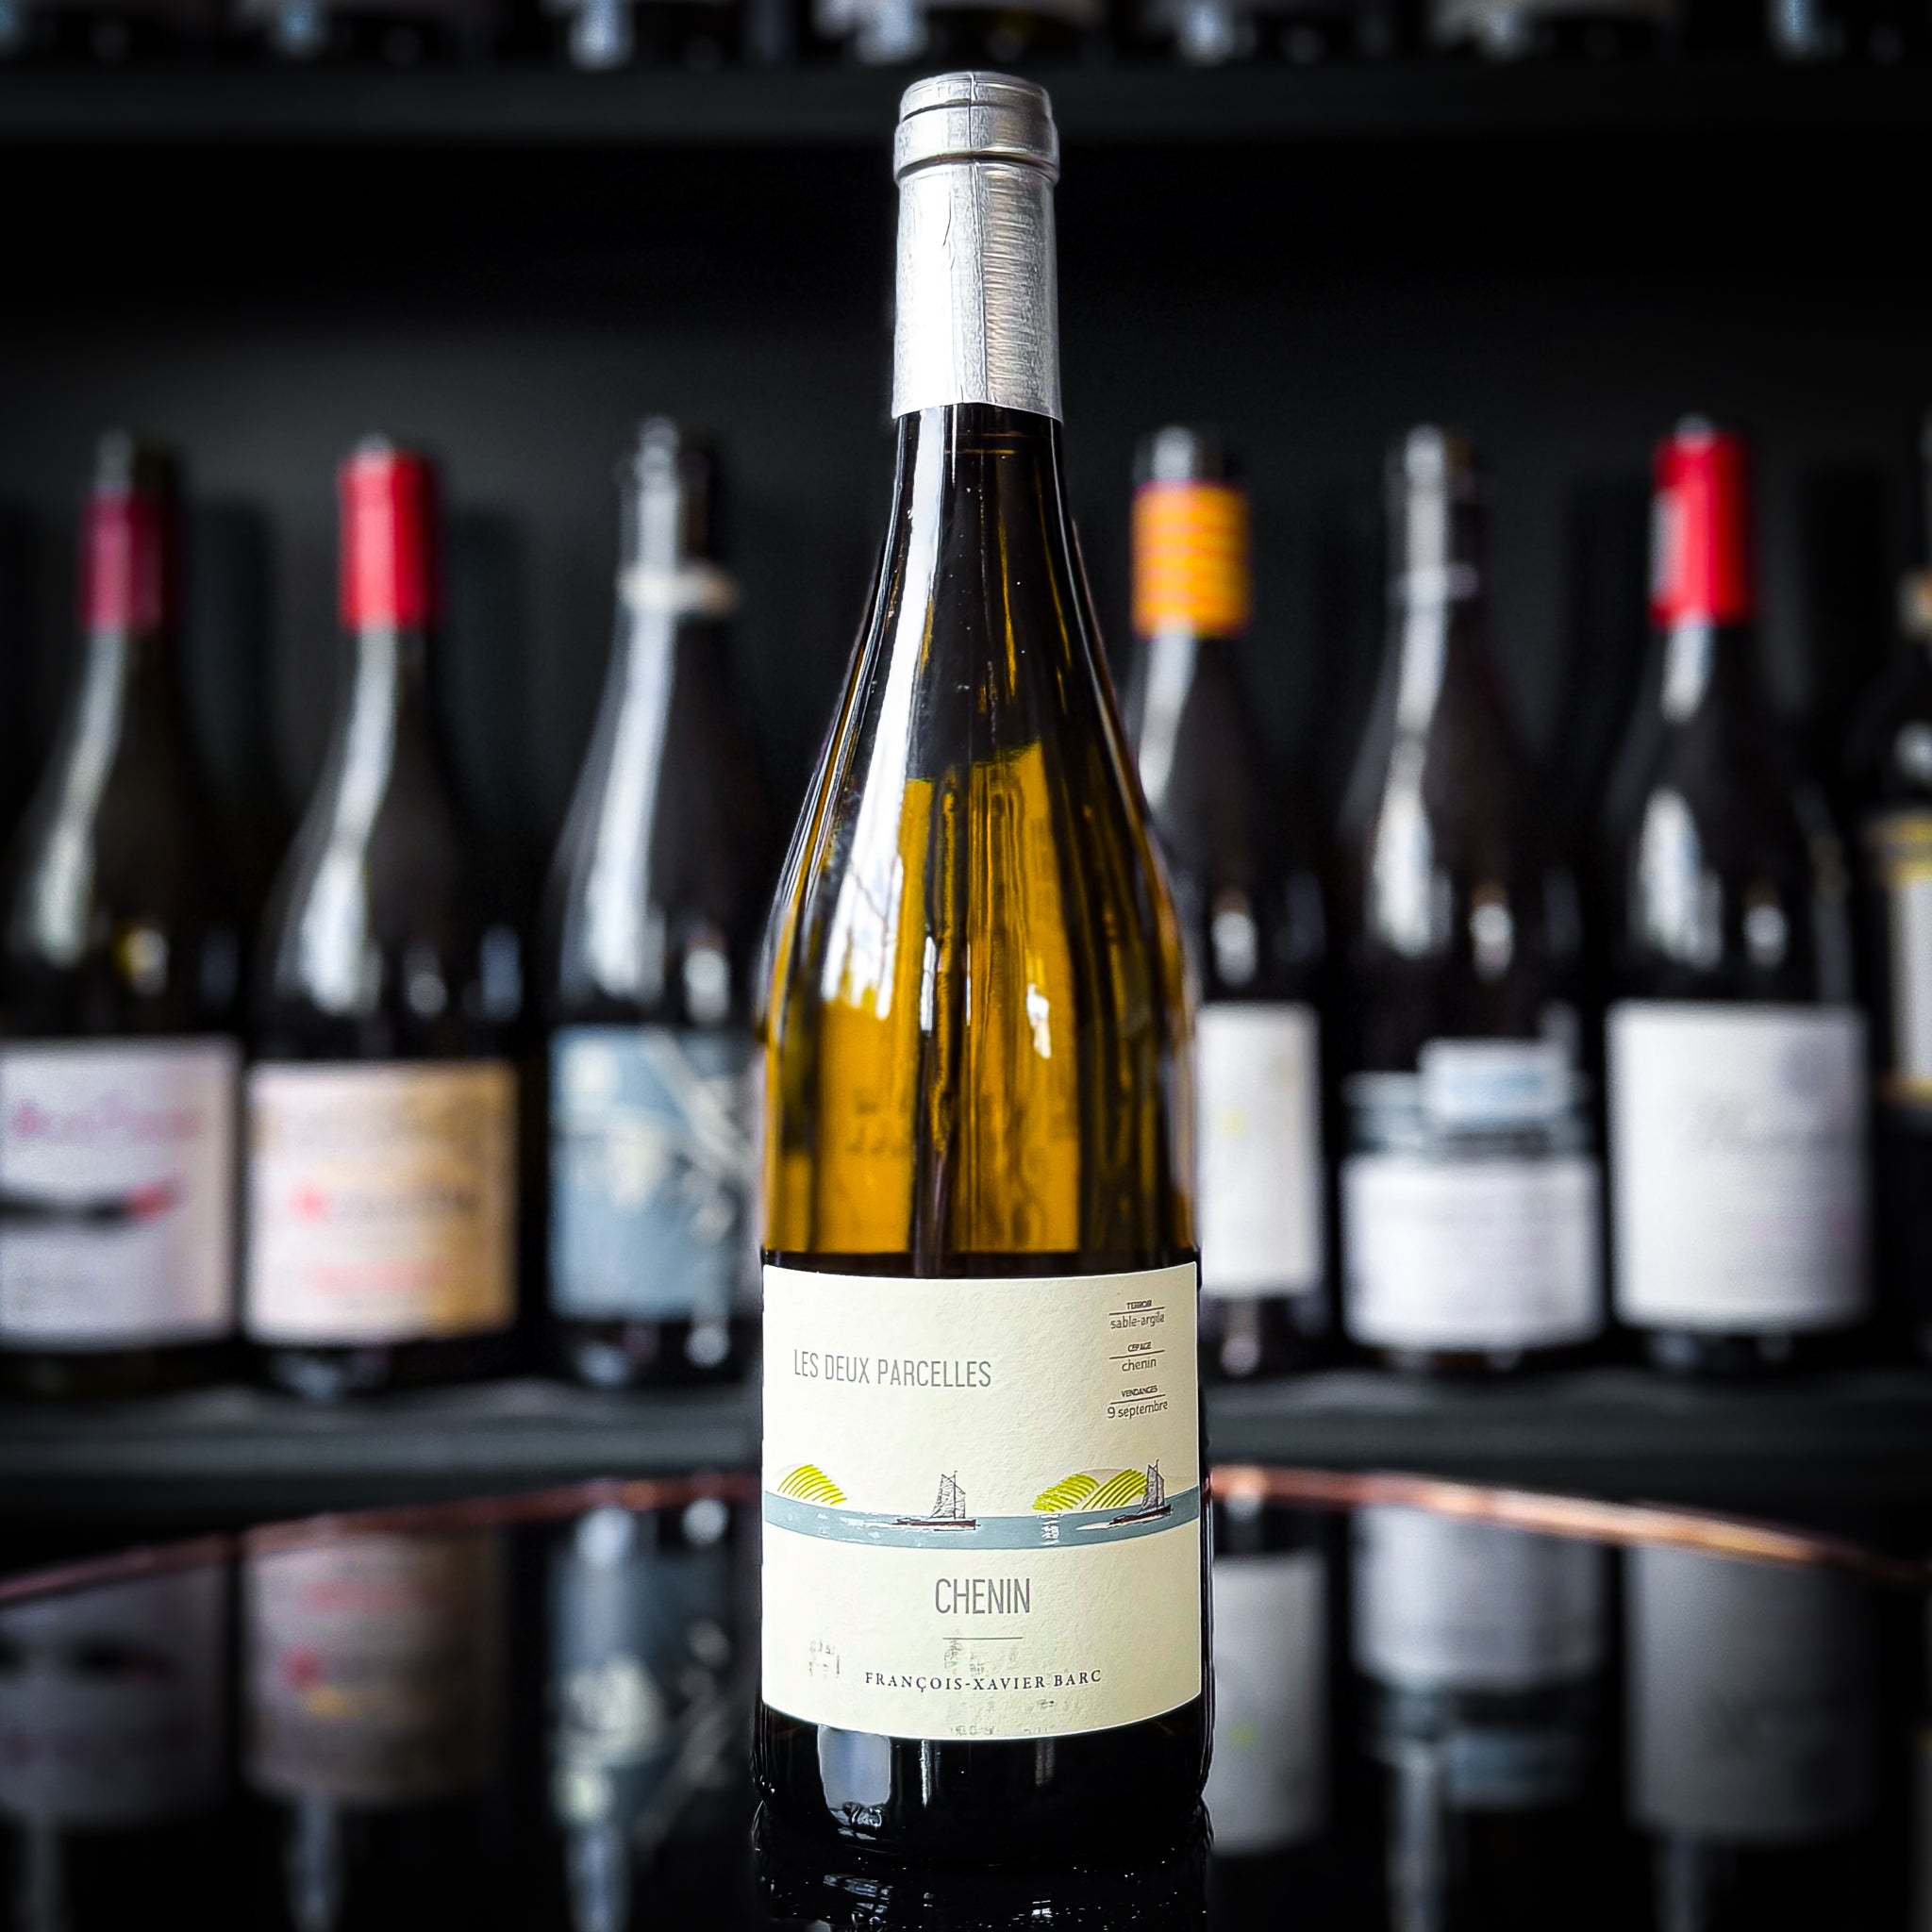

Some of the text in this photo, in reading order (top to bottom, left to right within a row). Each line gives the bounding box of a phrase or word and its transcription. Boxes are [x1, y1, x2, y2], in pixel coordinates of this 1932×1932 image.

[1110, 1311, 1165, 1329] sable-argile
[794, 1349, 991, 1388] LES DEUX PARCELLES
[1122, 1357, 1157, 1372] chenin
[1121, 1385, 1158, 1397] VENDANGES
[1107, 1400, 1169, 1420] 9 septembre
[935, 1577, 1030, 1614] CHENIN
[865, 1670, 1103, 1692] FRANÇOIS-XAVIER BARC
